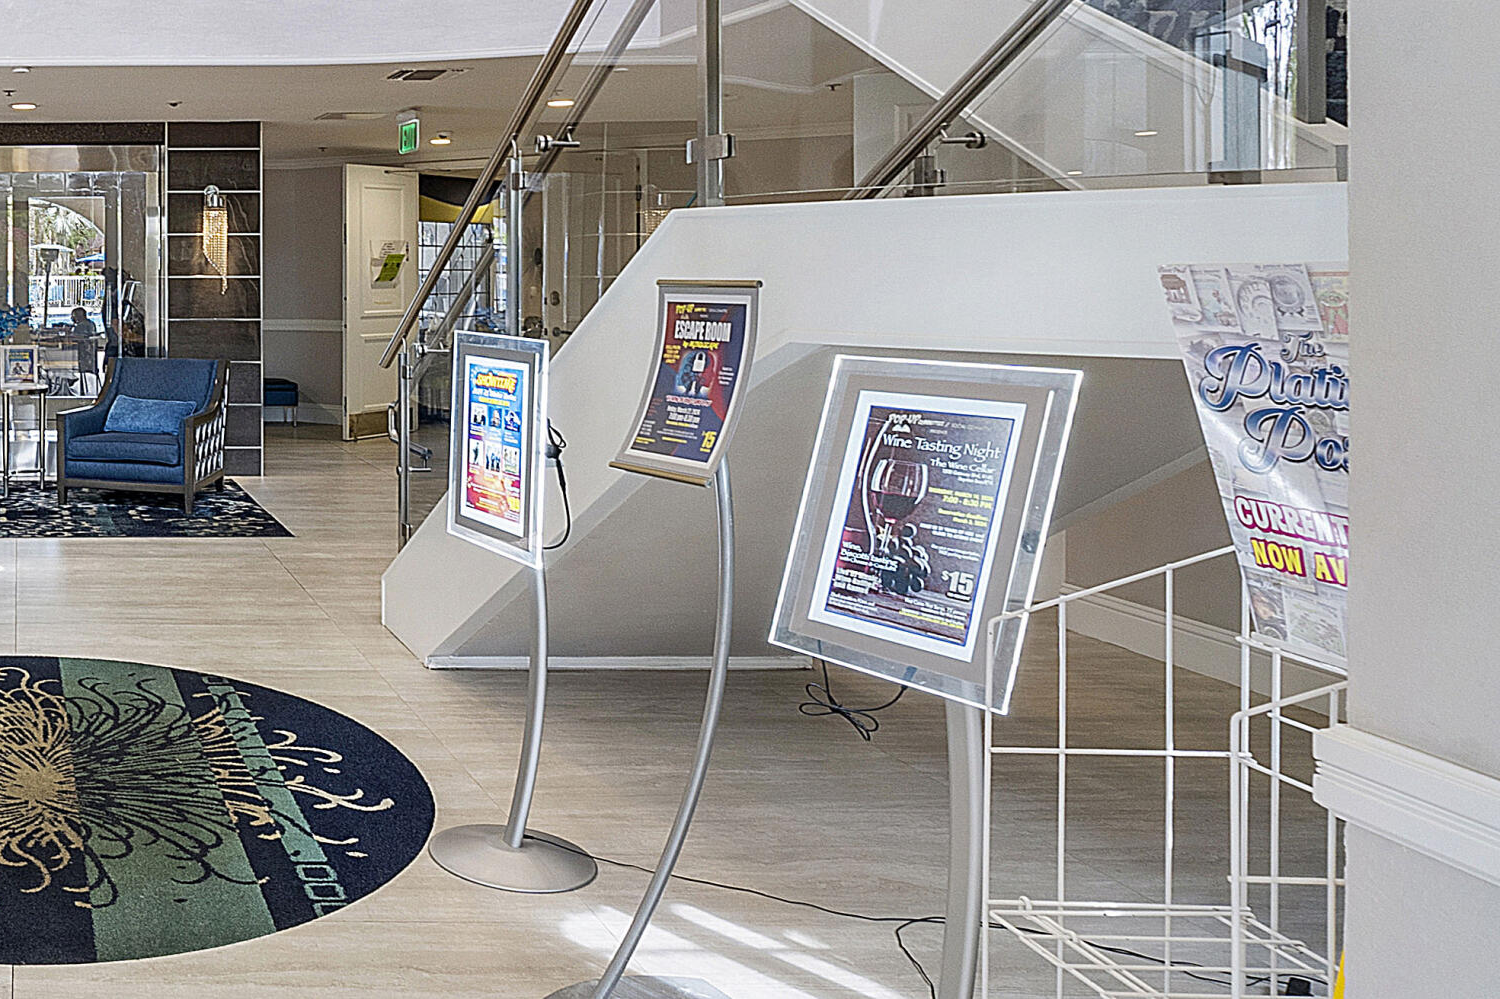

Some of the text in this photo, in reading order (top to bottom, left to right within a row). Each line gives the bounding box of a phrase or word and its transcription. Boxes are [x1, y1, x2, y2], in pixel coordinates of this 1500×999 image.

[674, 320, 732, 342] ESCAPE ROOM
[1280, 331, 1326, 364] The
[882, 433, 1001, 463] Wine Tasting Night
[930, 457, 947, 468] The
[947, 461, 968, 471] Wine
[1234, 495, 1348, 550] CURRENT
[1250, 536, 1307, 578] NOW
[941, 570, 975, 595] $15
